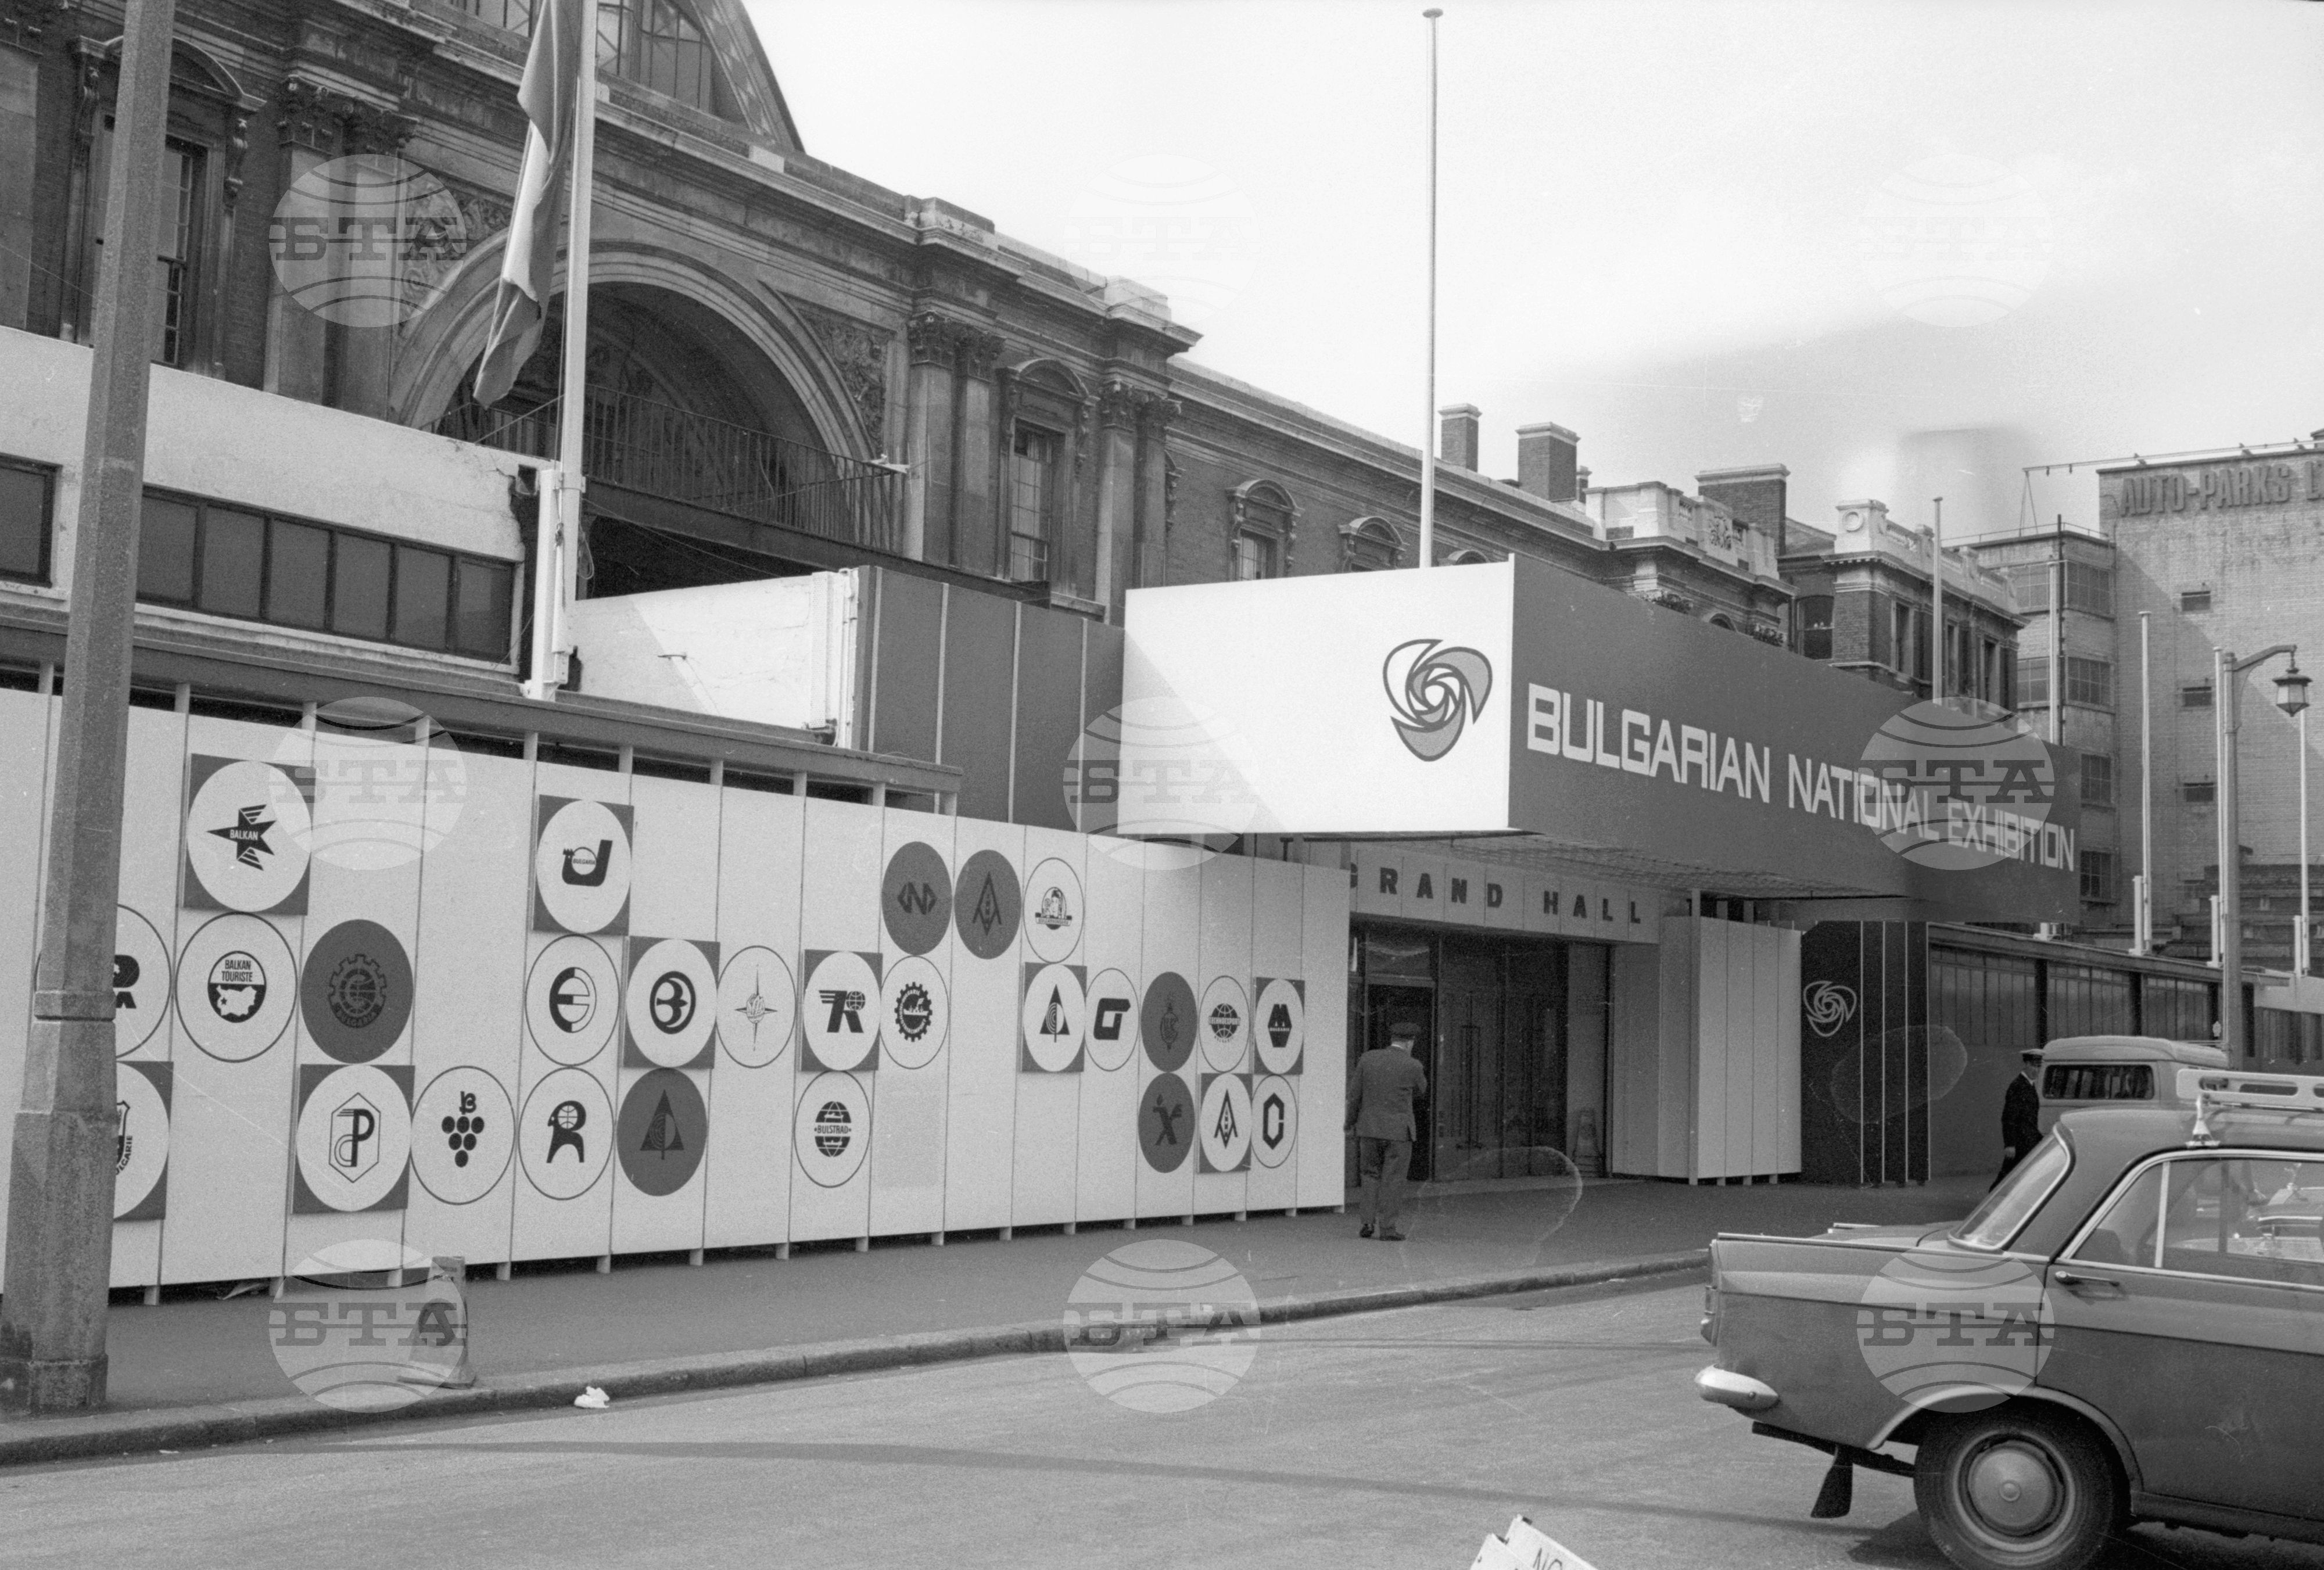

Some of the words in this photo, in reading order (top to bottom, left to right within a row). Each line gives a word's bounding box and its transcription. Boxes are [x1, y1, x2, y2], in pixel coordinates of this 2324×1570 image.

[2121, 464, 2291, 517] AUTO-PARKS
[1527, 683, 1770, 804] BULGARIAN
[1788, 754, 1939, 841] NATIONAL
[1948, 797, 2075, 872] EXHIBITION
[230, 830, 259, 840] BALKAN
[1544, 891, 1641, 924] HALL
[225, 959, 251, 970] BALKAN
[221, 971, 253, 982] TOURISTE
[817, 1125, 848, 1134] BULSTRAD
